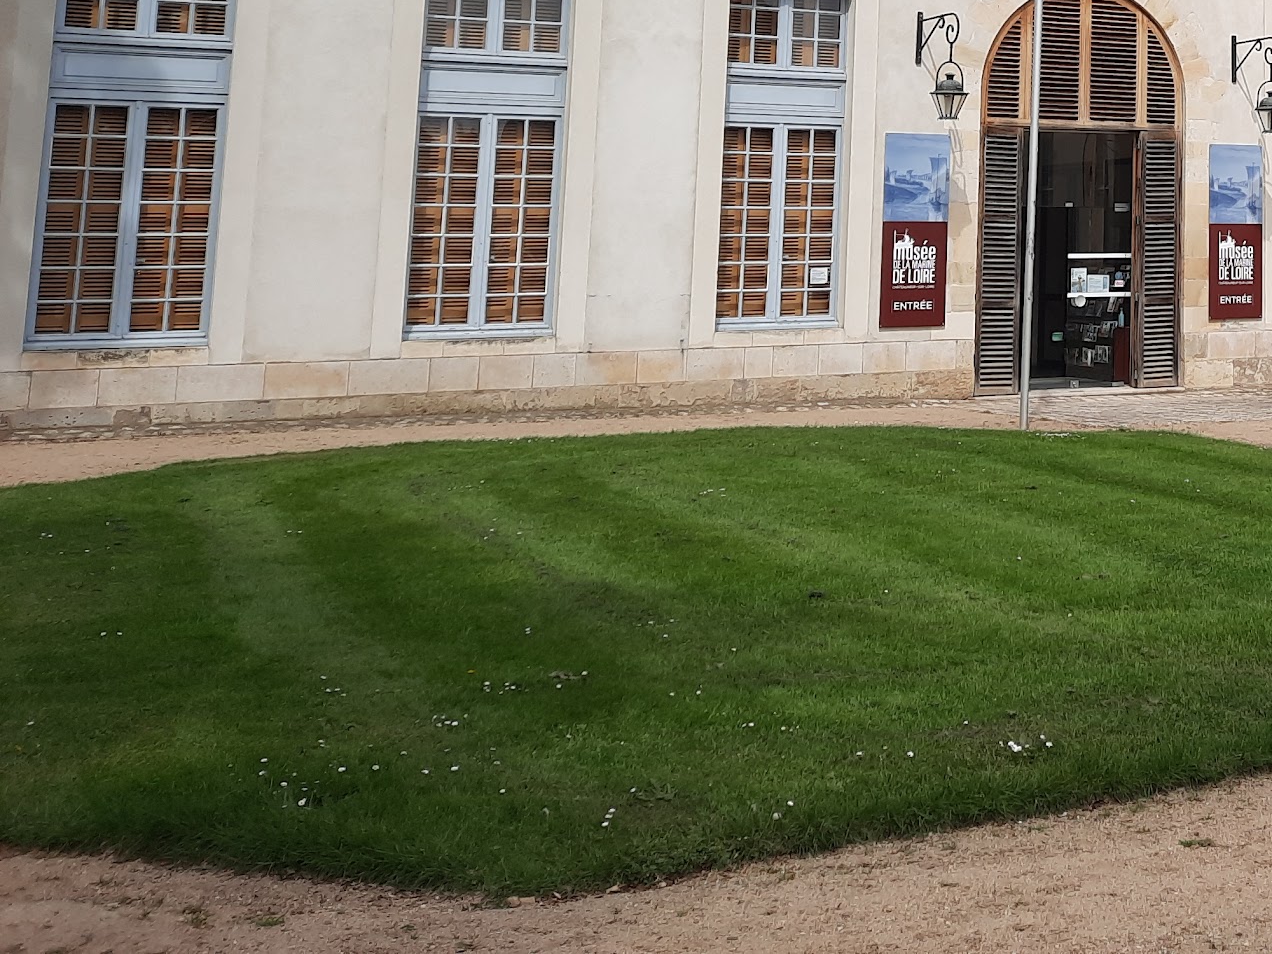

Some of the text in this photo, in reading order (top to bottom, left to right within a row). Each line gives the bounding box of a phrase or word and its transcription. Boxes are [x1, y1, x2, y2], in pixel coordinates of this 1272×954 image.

[893, 239, 936, 260] musée
[1218, 240, 1254, 259] musée
[893, 260, 902, 269] DE
[902, 260, 911, 269] LA
[1219, 258, 1226, 267] DE
[1226, 258, 1233, 267] LA
[892, 269, 936, 284] DE LOIRE
[1218, 266, 1254, 280] DE LOIRE
[893, 299, 933, 311] ENTRÉE
[1220, 293, 1253, 305] ENTRÉE
